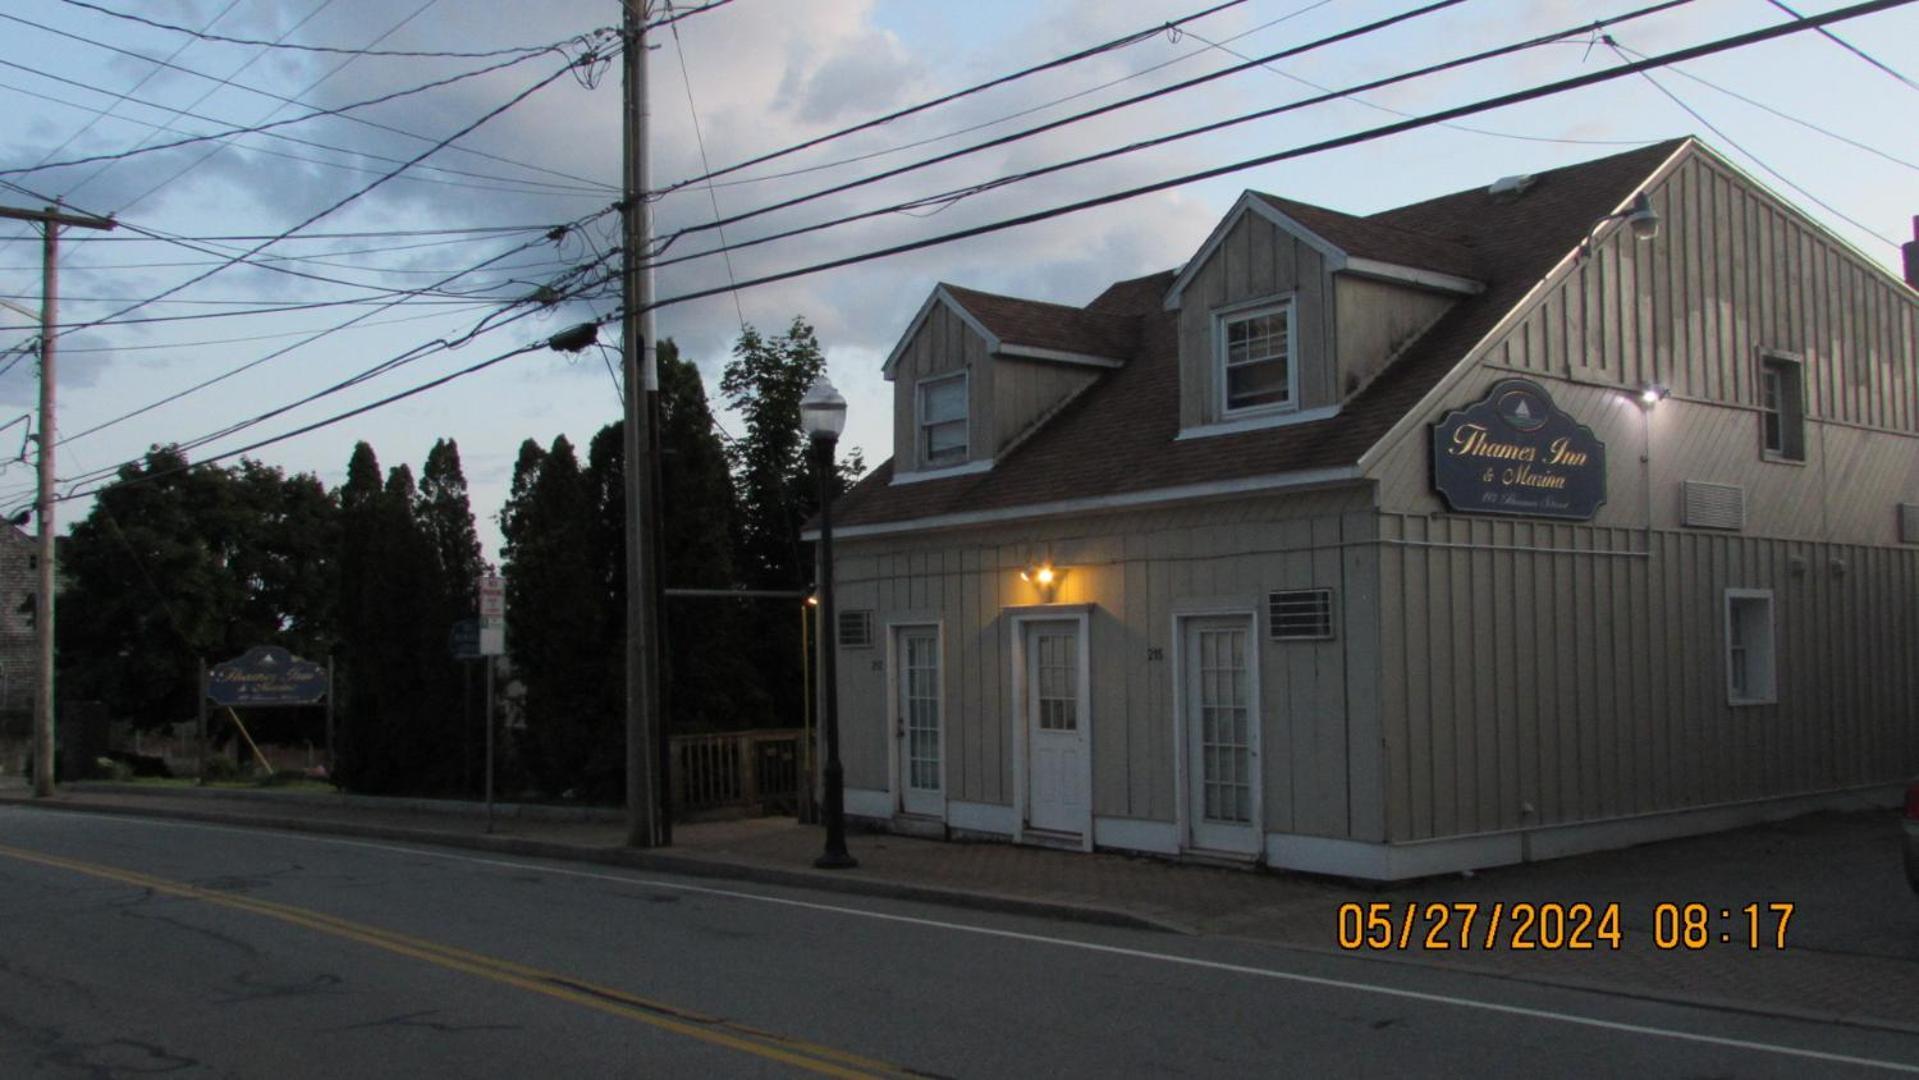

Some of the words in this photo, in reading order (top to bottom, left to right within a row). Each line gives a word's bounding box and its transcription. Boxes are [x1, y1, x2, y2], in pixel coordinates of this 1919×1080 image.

[1448, 423, 1537, 462] Thames
[1541, 436, 1589, 466] Inn
[1482, 467, 1494, 483] &
[1501, 464, 1567, 489] Marina
